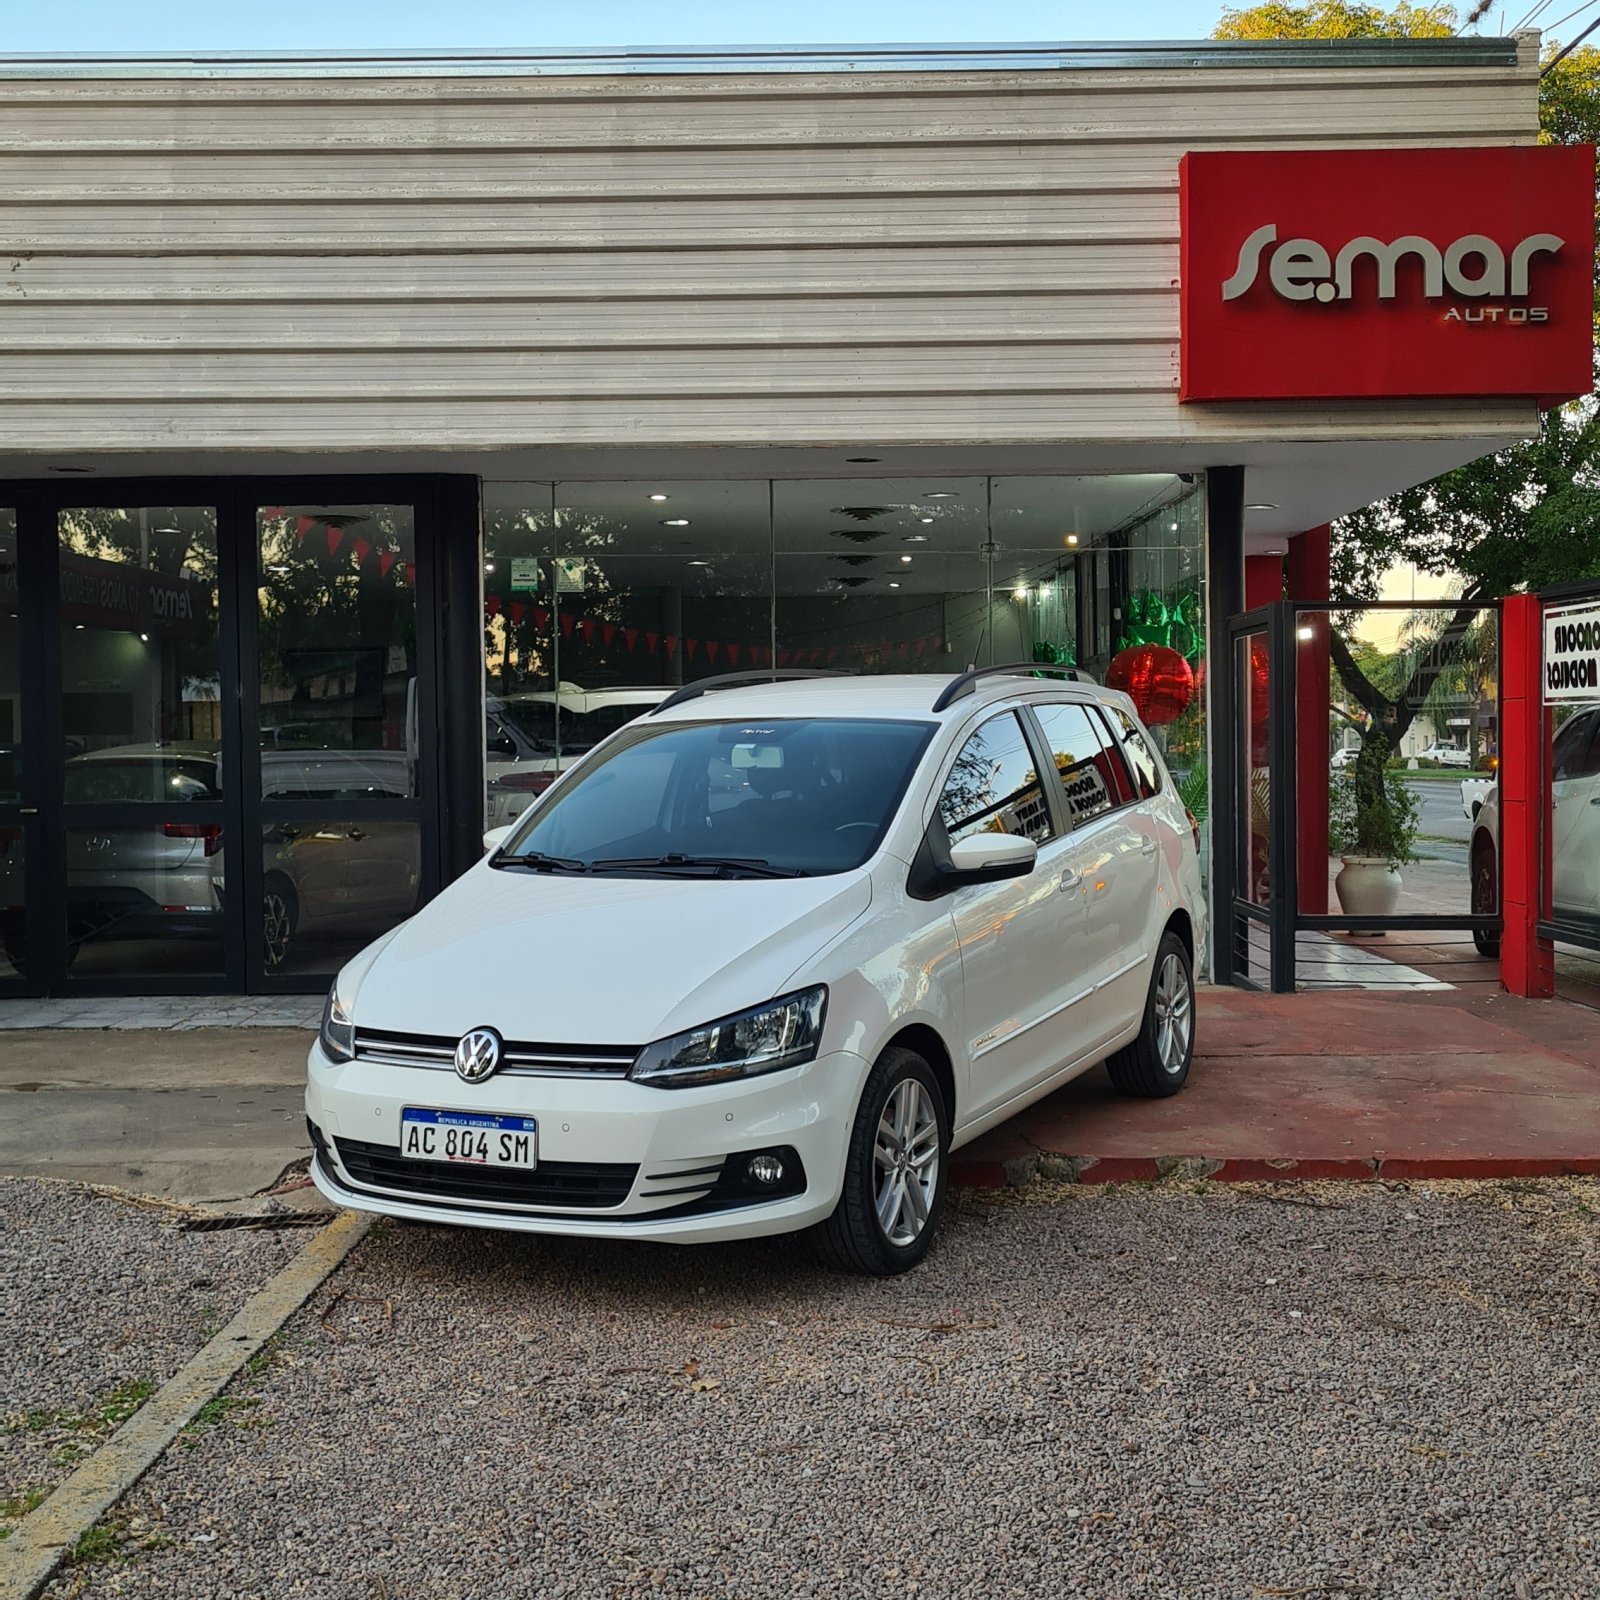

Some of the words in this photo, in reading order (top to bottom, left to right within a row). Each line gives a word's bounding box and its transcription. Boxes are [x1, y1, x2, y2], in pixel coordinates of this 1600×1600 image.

[1443, 307, 1549, 322] AUTOS
[468, 1118, 500, 1128] ARGENTINA
[407, 1126, 435, 1154] AC
[445, 1129, 488, 1159] 804
[498, 1134, 529, 1163] SM
